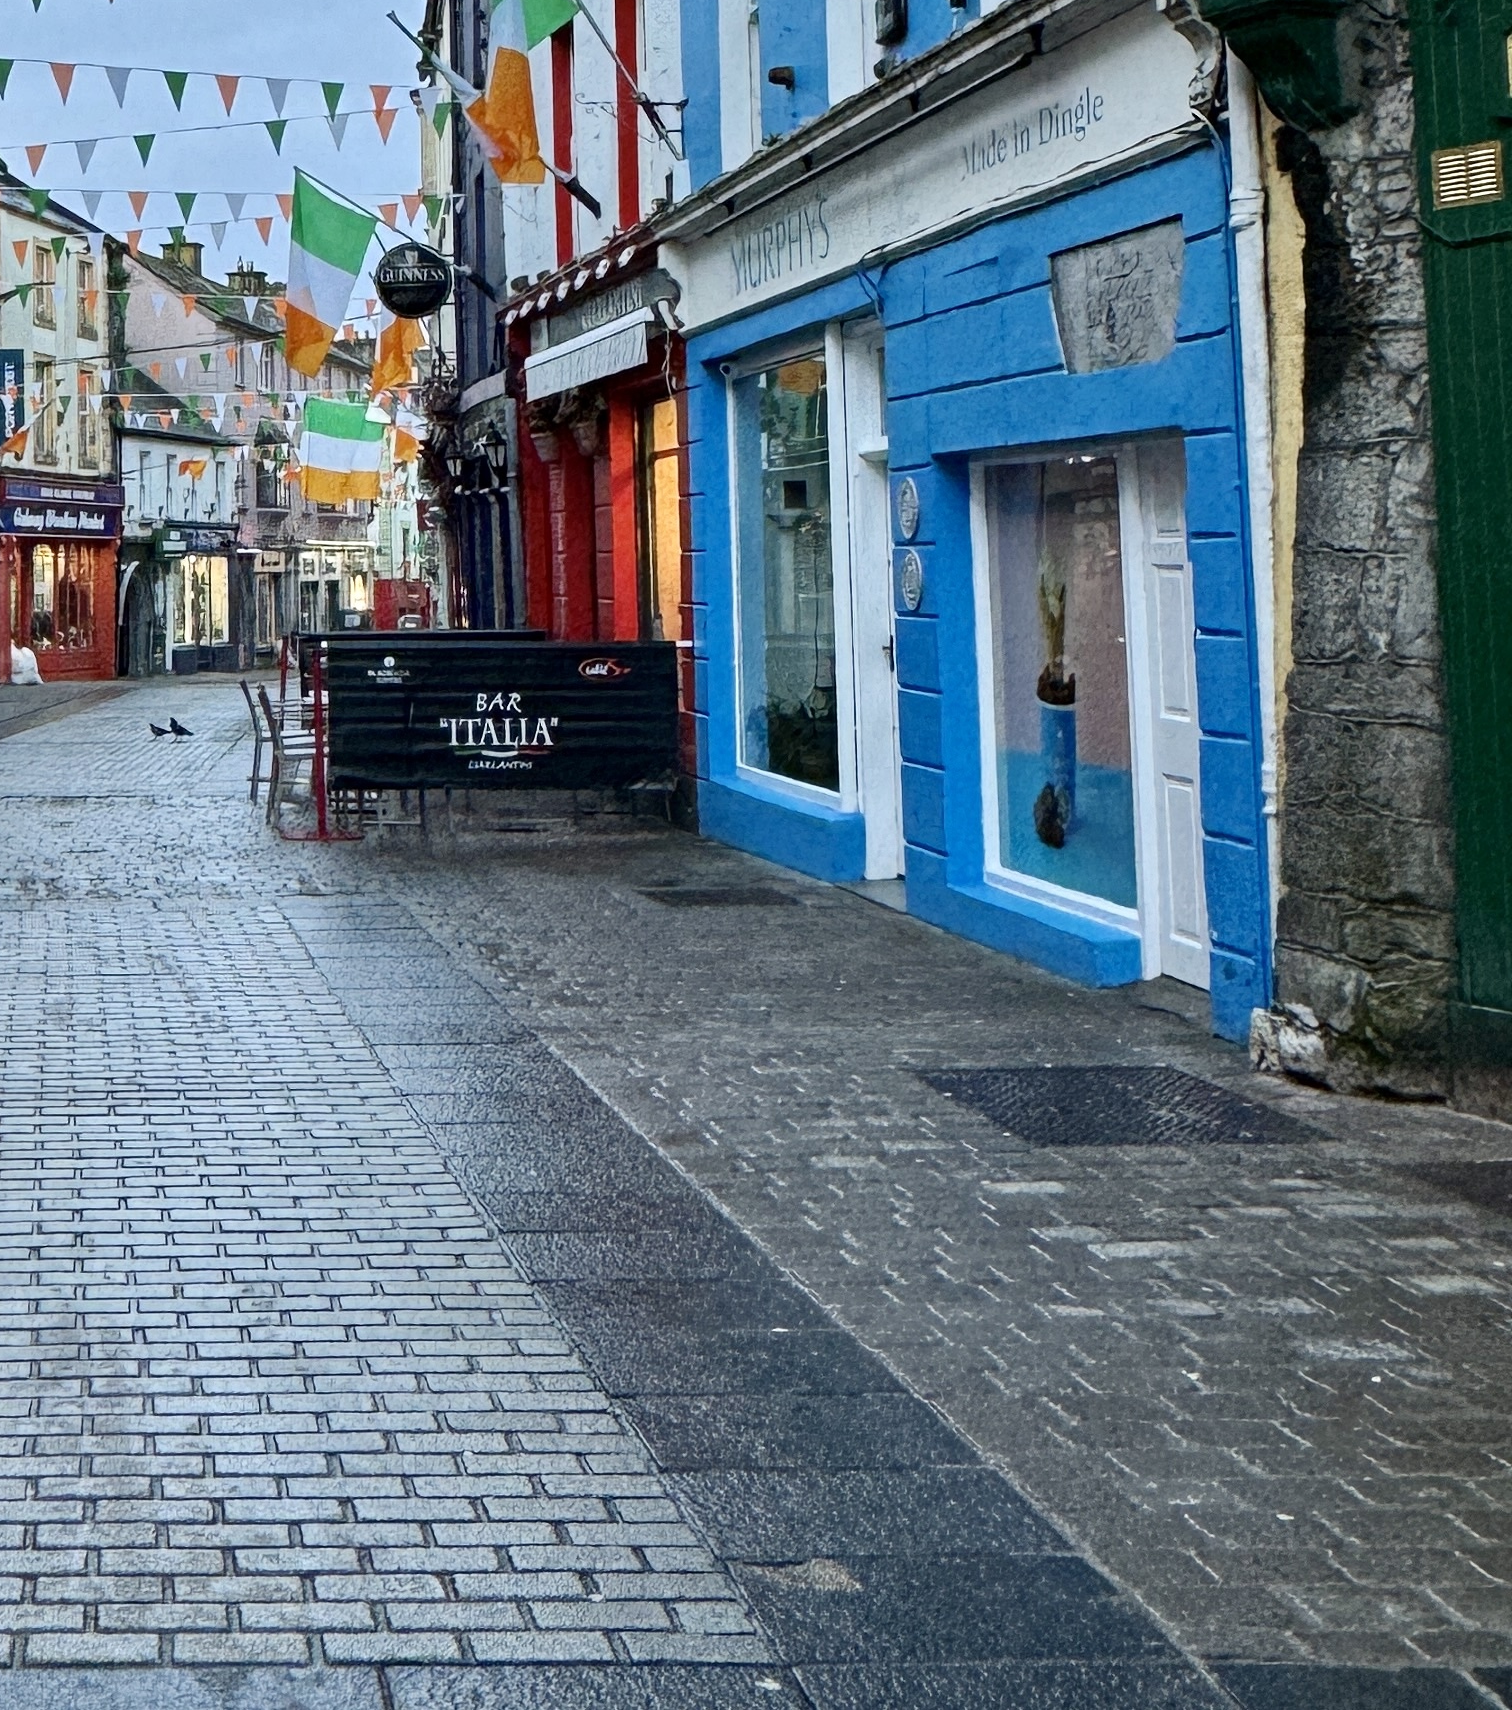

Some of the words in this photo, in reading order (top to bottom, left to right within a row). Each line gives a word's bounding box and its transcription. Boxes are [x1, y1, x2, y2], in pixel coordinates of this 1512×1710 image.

[1038, 86, 1104, 142] Dingle
[380, 267, 446, 283] GUINNESS
[476, 692, 523, 713] BAR
